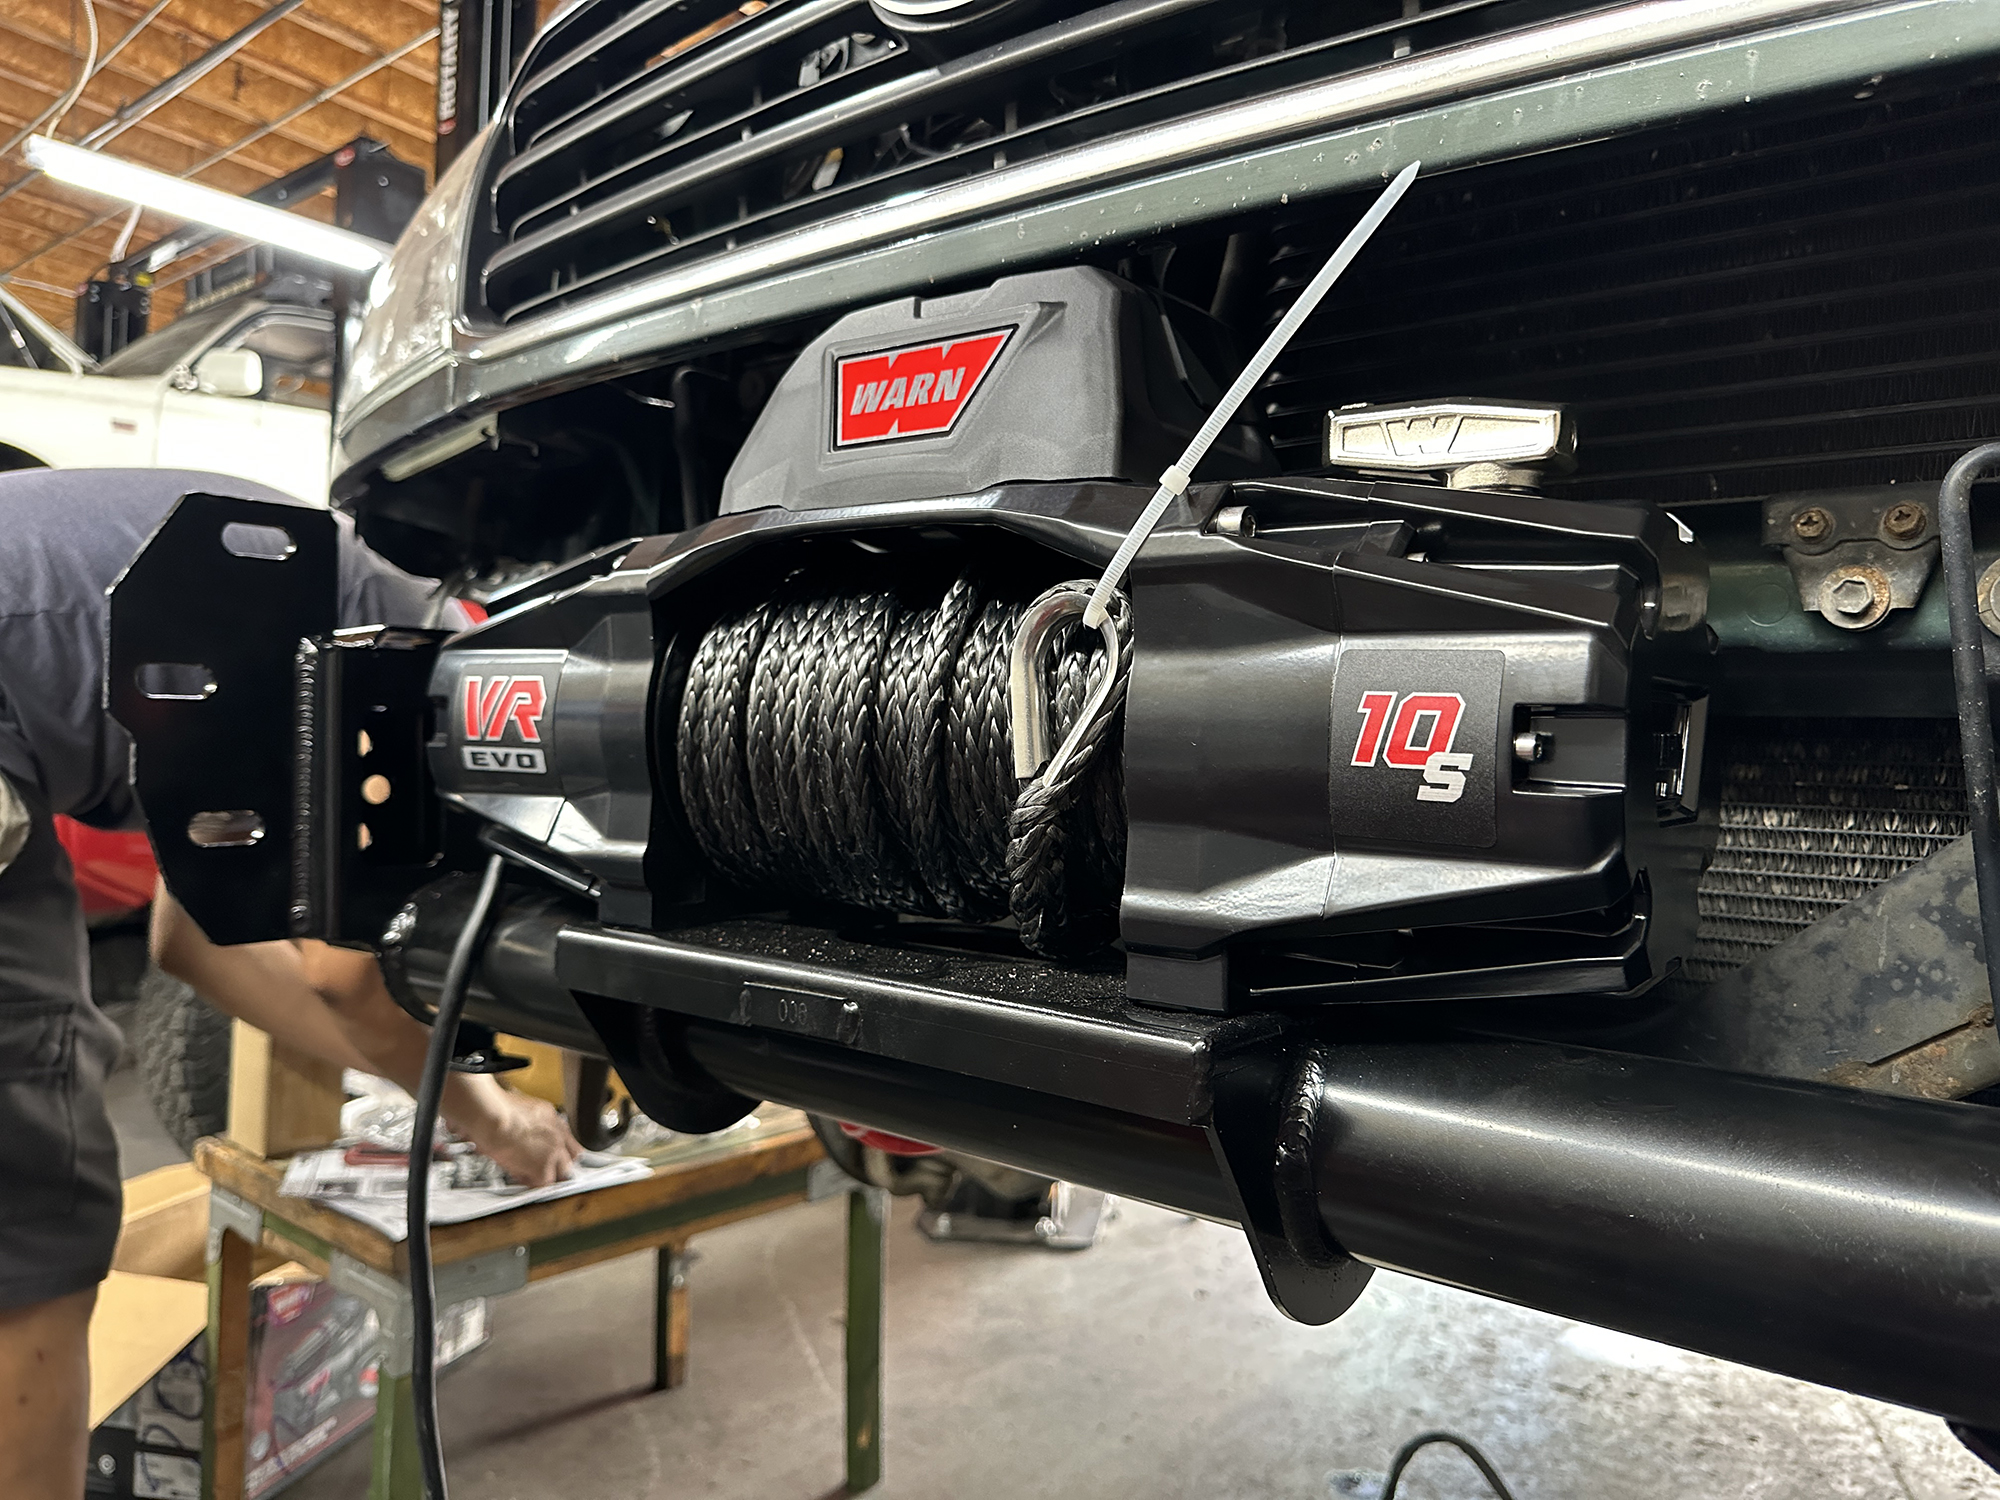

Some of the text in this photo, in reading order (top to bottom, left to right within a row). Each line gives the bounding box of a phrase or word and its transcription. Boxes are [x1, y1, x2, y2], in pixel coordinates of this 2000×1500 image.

[438, 8, 459, 121] ROTARY
[850, 366, 966, 416] WARN
[465, 675, 547, 743] VR
[470, 751, 538, 769] EVO
